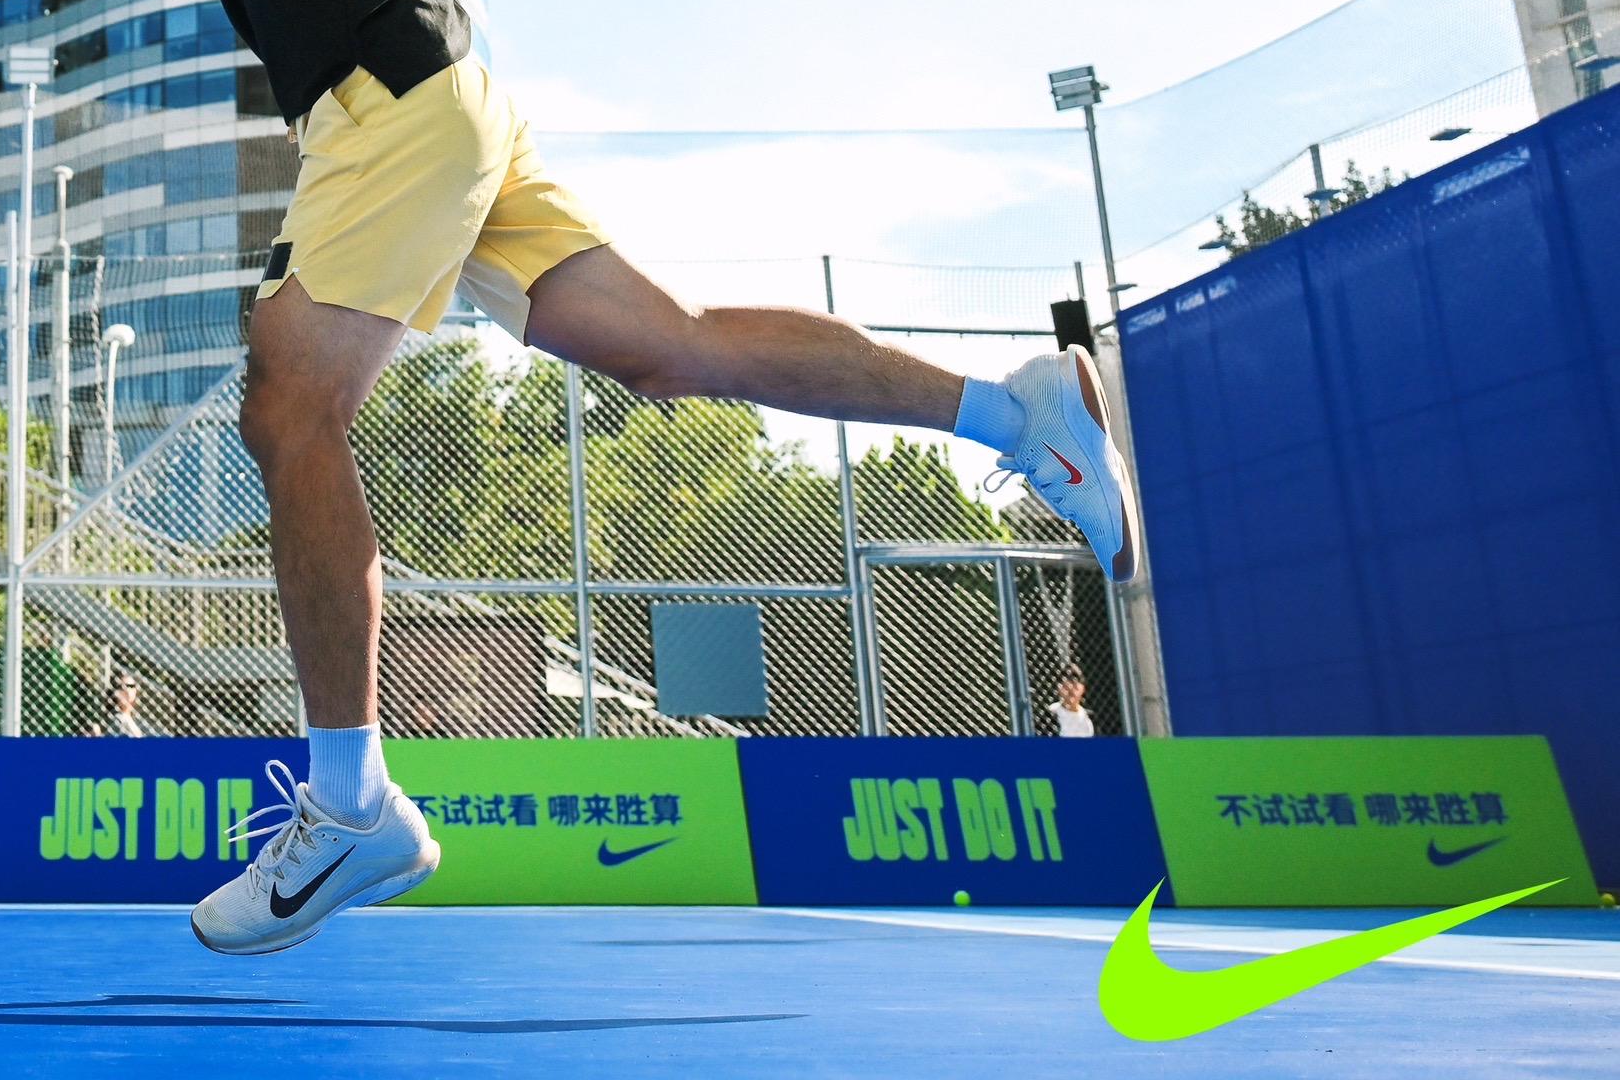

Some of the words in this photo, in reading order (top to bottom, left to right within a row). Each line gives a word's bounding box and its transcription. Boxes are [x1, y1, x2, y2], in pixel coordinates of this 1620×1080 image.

[40, 778, 143, 860] JUST
[155, 778, 205, 861] DO
[217, 778, 253, 861] IT
[547, 793, 683, 826] 哪来胜算
[842, 778, 949, 861] JUST
[952, 778, 1017, 861] DO
[1016, 778, 1063, 861] IT
[1215, 791, 1357, 828] 不试试看
[1363, 791, 1508, 827] 哪来胜算
